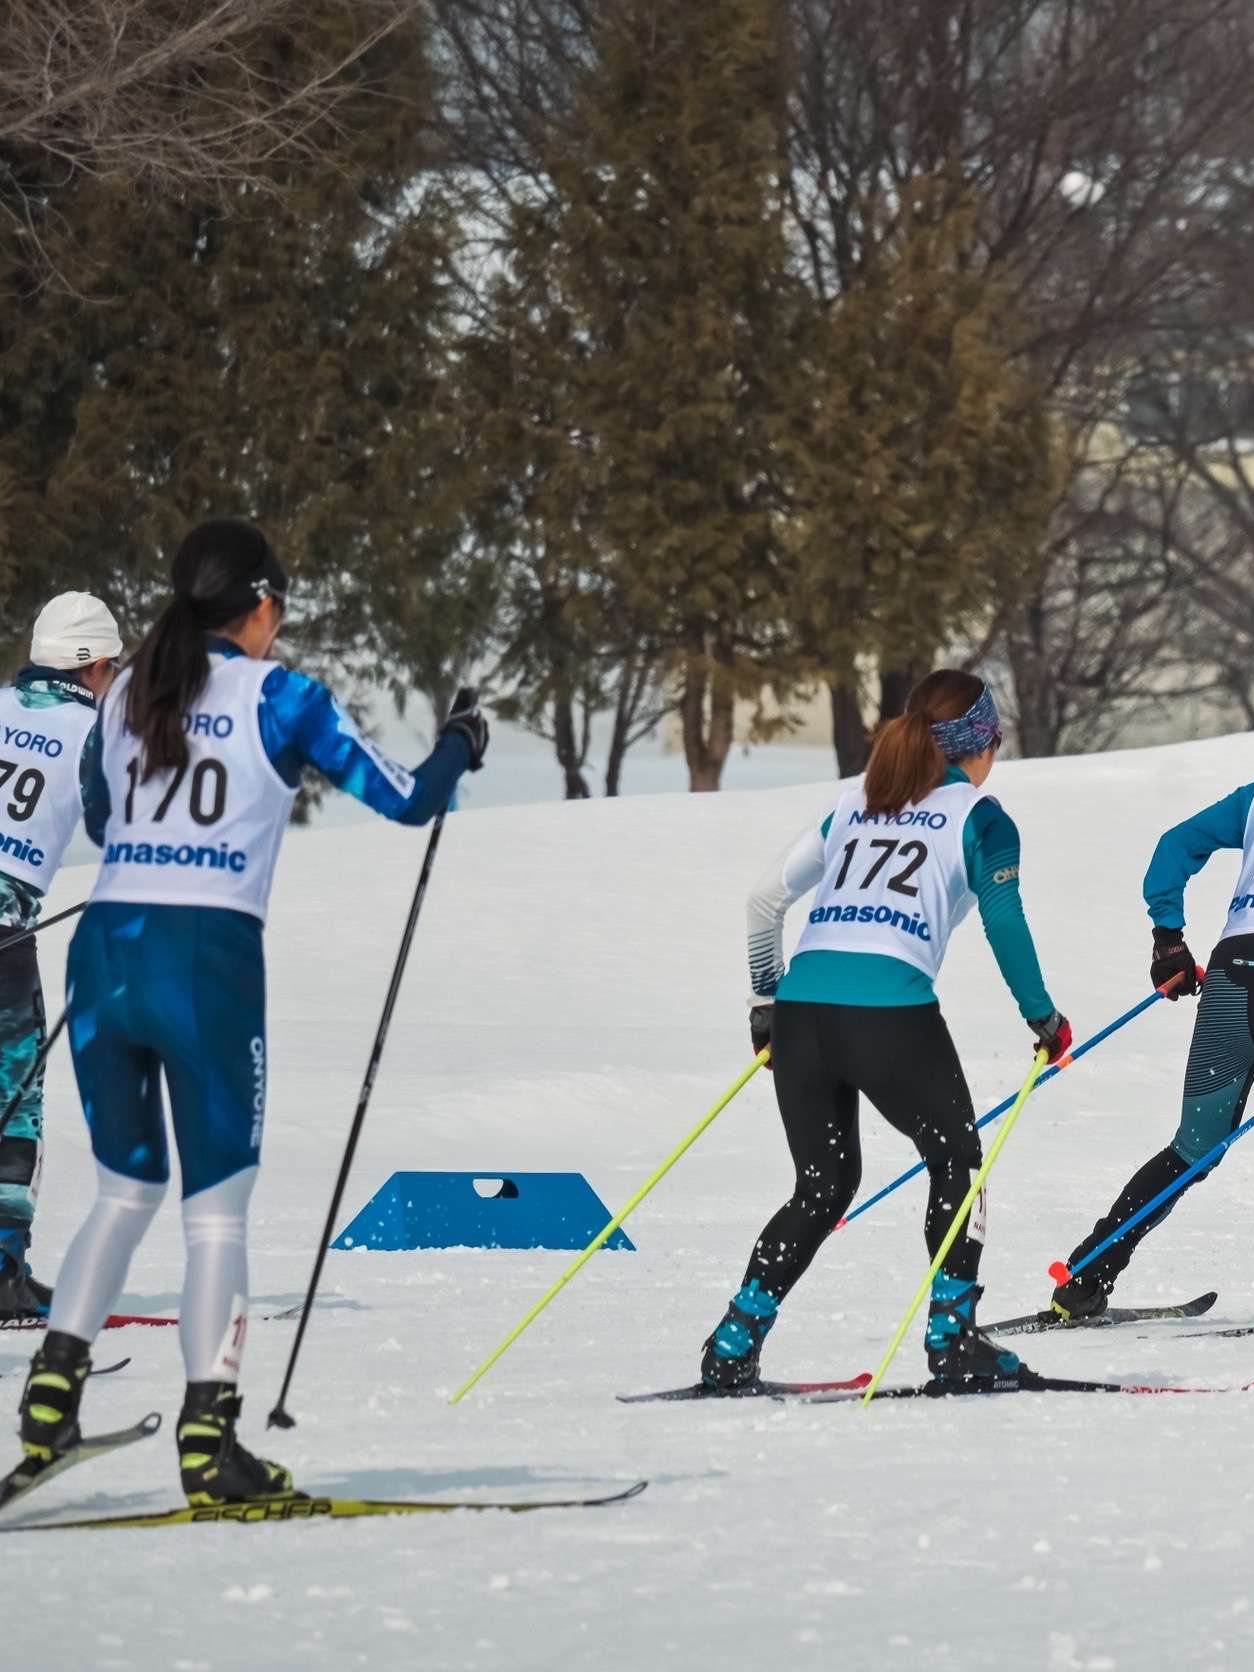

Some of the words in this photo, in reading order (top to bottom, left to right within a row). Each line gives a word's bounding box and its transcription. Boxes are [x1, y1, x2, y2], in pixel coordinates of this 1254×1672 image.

[0, 725, 63, 758] YORO
[125, 757, 227, 826] 170
[834, 838, 928, 897] 172
[809, 905, 931, 941] anasonic
